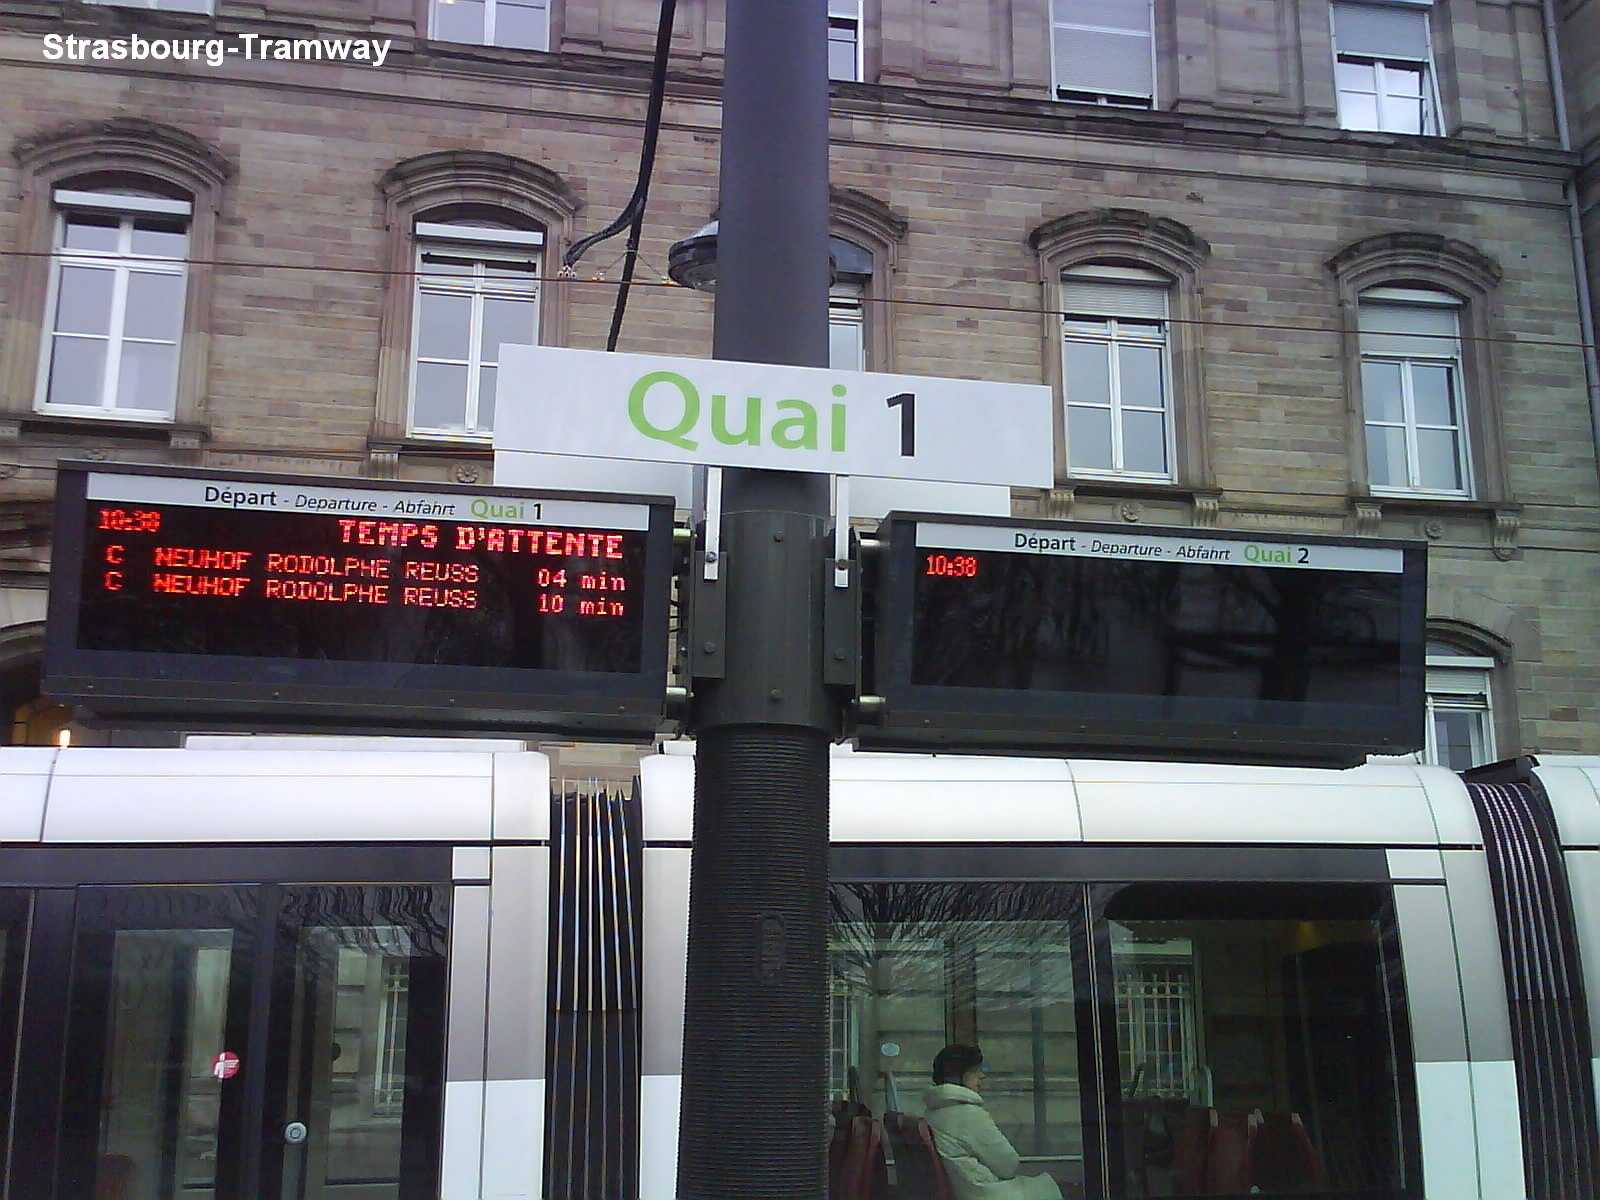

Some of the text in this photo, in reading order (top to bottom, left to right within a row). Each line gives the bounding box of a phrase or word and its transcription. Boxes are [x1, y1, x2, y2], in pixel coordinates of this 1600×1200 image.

[628, 370, 916, 457] Quai 1
[205, 486, 277, 507] Départ
[295, 494, 377, 512] Departure
[393, 500, 455, 516] Abfahrt
[470, 499, 525, 520] Quai
[533, 503, 542, 520] 1
[338, 520, 623, 559] TEMPS D'ATTENTE
[1014, 532, 1076, 552] Départ
[1091, 540, 1162, 558] Departure
[1176, 546, 1232, 561] Abfahrt
[1244, 544, 1293, 564] Quai
[1297, 547, 1310, 564] 2
[106, 545, 627, 592] C NEUHOF RODOLPHE REUSS 04 min
[926, 555, 976, 577] 10:38
[103, 571, 625, 617] C NEUHOF RODOLPHE REUSS 10 min
